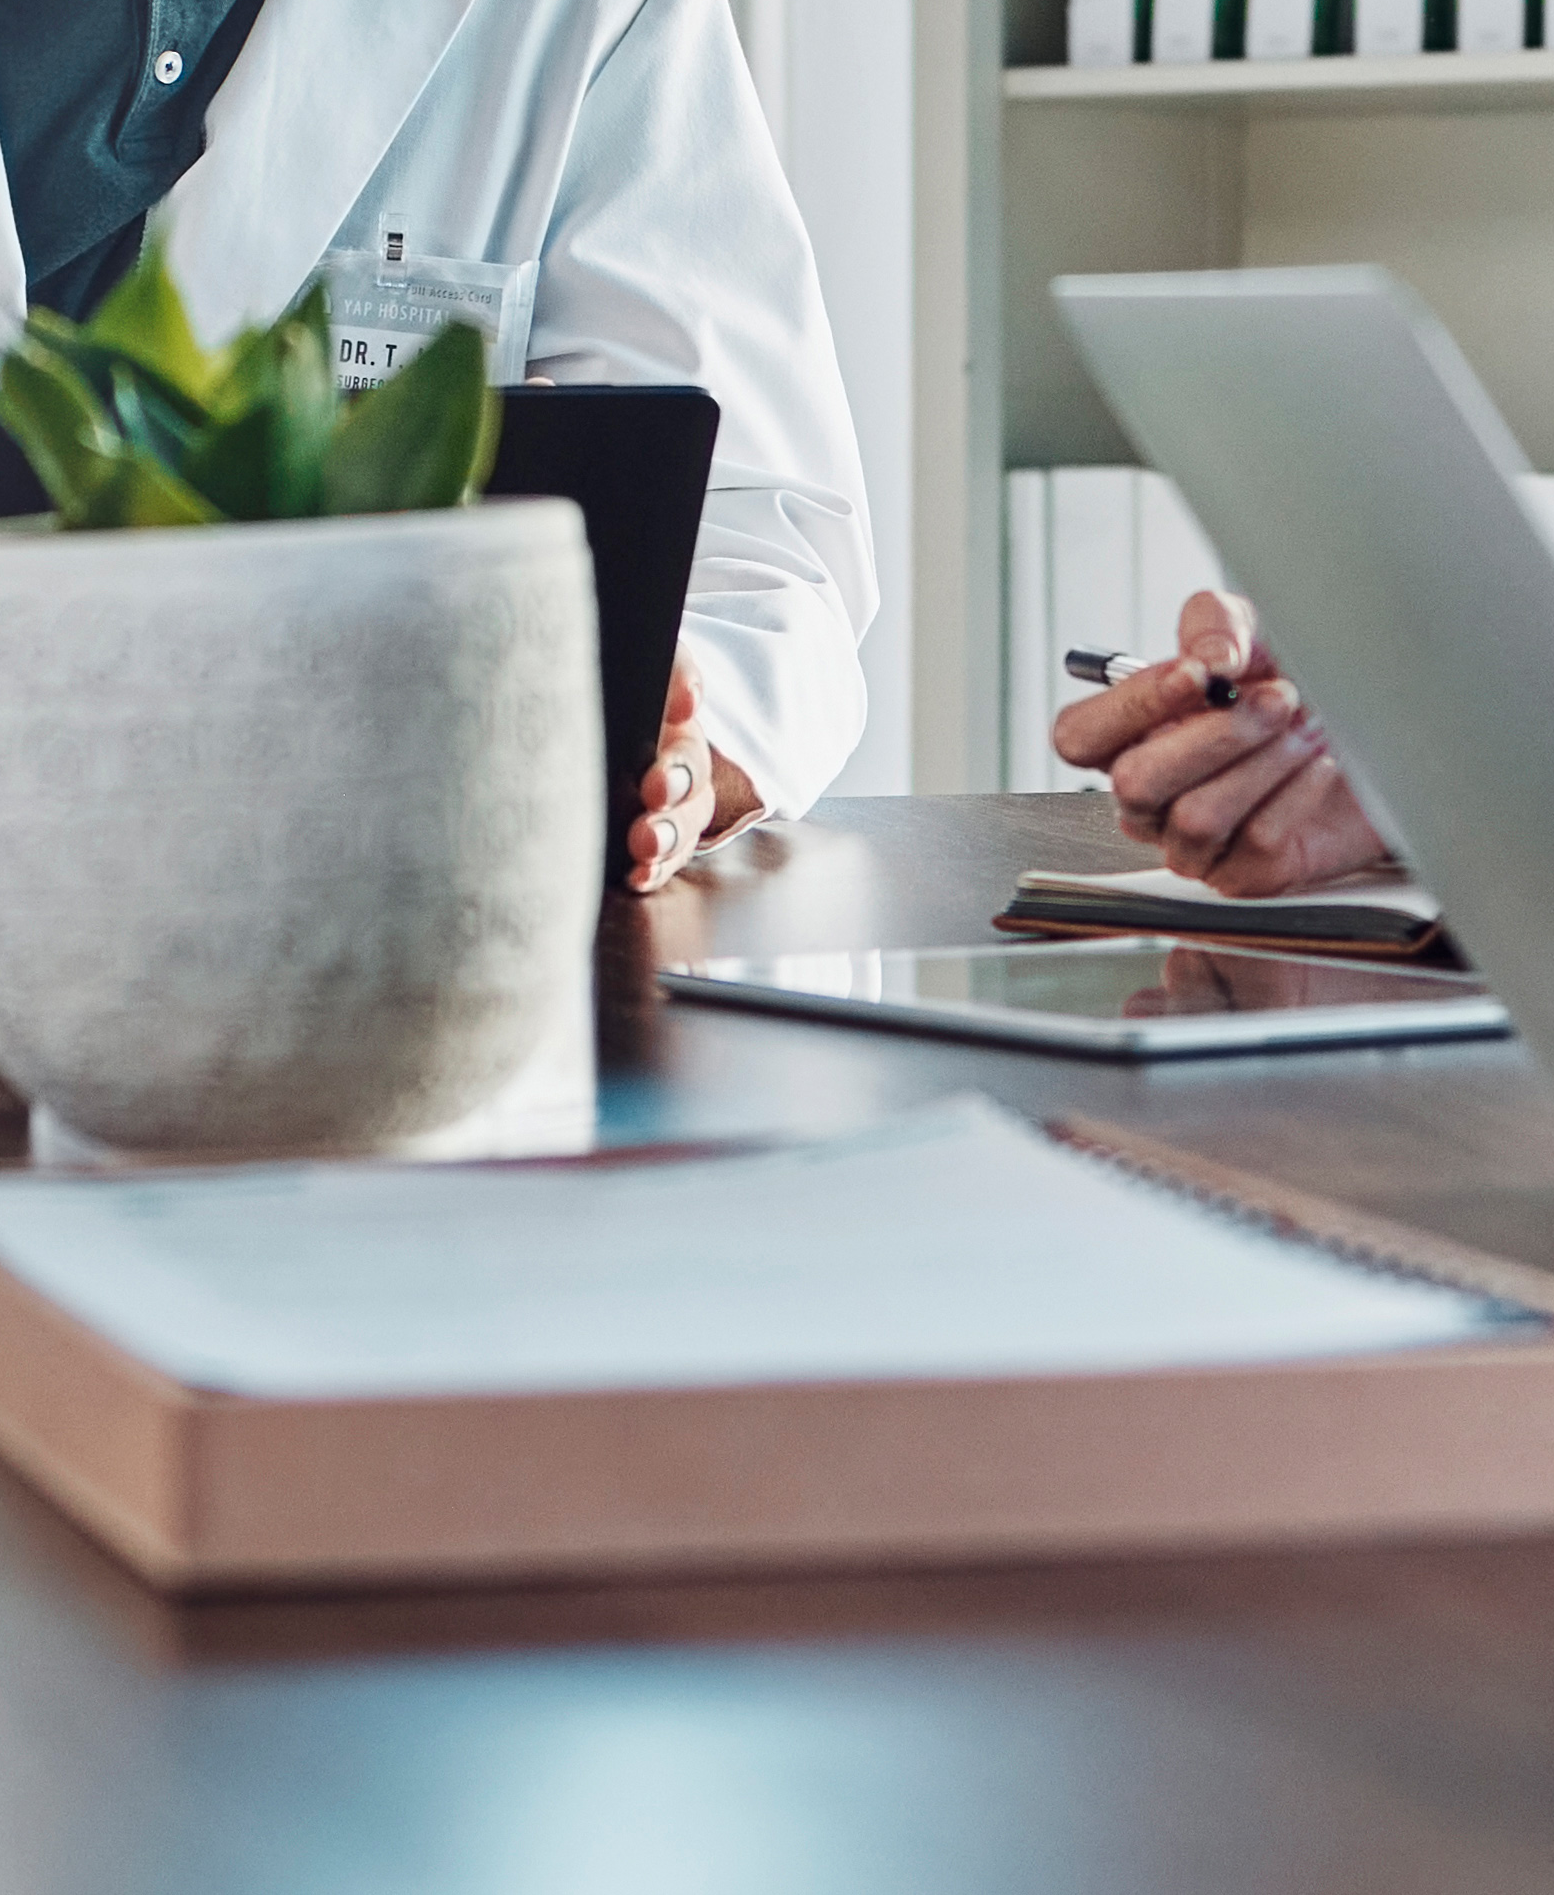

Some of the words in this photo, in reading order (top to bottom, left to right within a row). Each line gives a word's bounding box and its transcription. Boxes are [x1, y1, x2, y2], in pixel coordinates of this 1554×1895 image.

[428, 286, 464, 301] Access
[344, 298, 372, 316] YAP
[340, 338, 376, 366] DR.
[386, 344, 405, 370] T.
